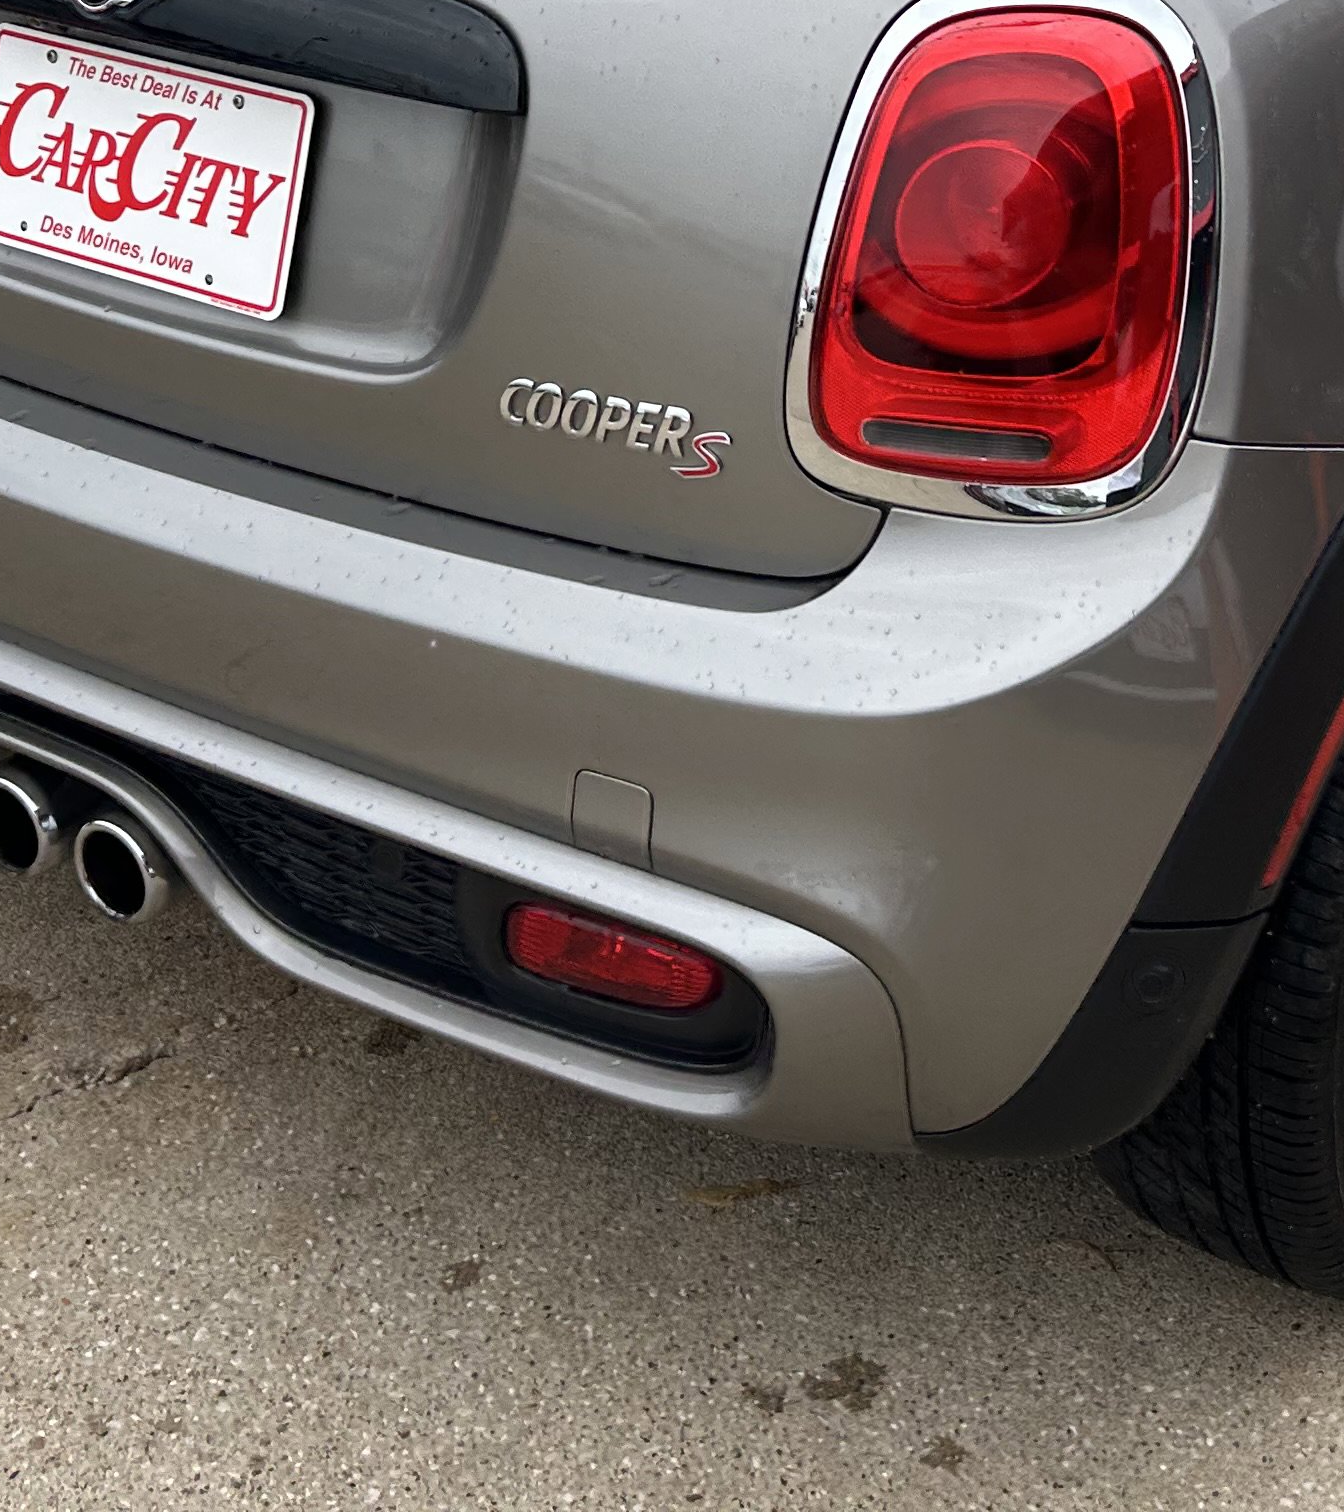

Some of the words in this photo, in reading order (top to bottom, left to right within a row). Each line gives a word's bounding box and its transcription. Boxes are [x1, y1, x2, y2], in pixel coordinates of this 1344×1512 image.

[68, 56, 97, 80] The
[99, 65, 137, 90] Best
[140, 74, 176, 100] Deal
[181, 84, 199, 106] Is
[199, 90, 223, 111] At
[39, 214, 73, 241] Des
[76, 224, 146, 264] Moines,
[150, 246, 194, 274] Iowa
[499, 377, 694, 458] COOPER
[669, 431, 732, 479] S
